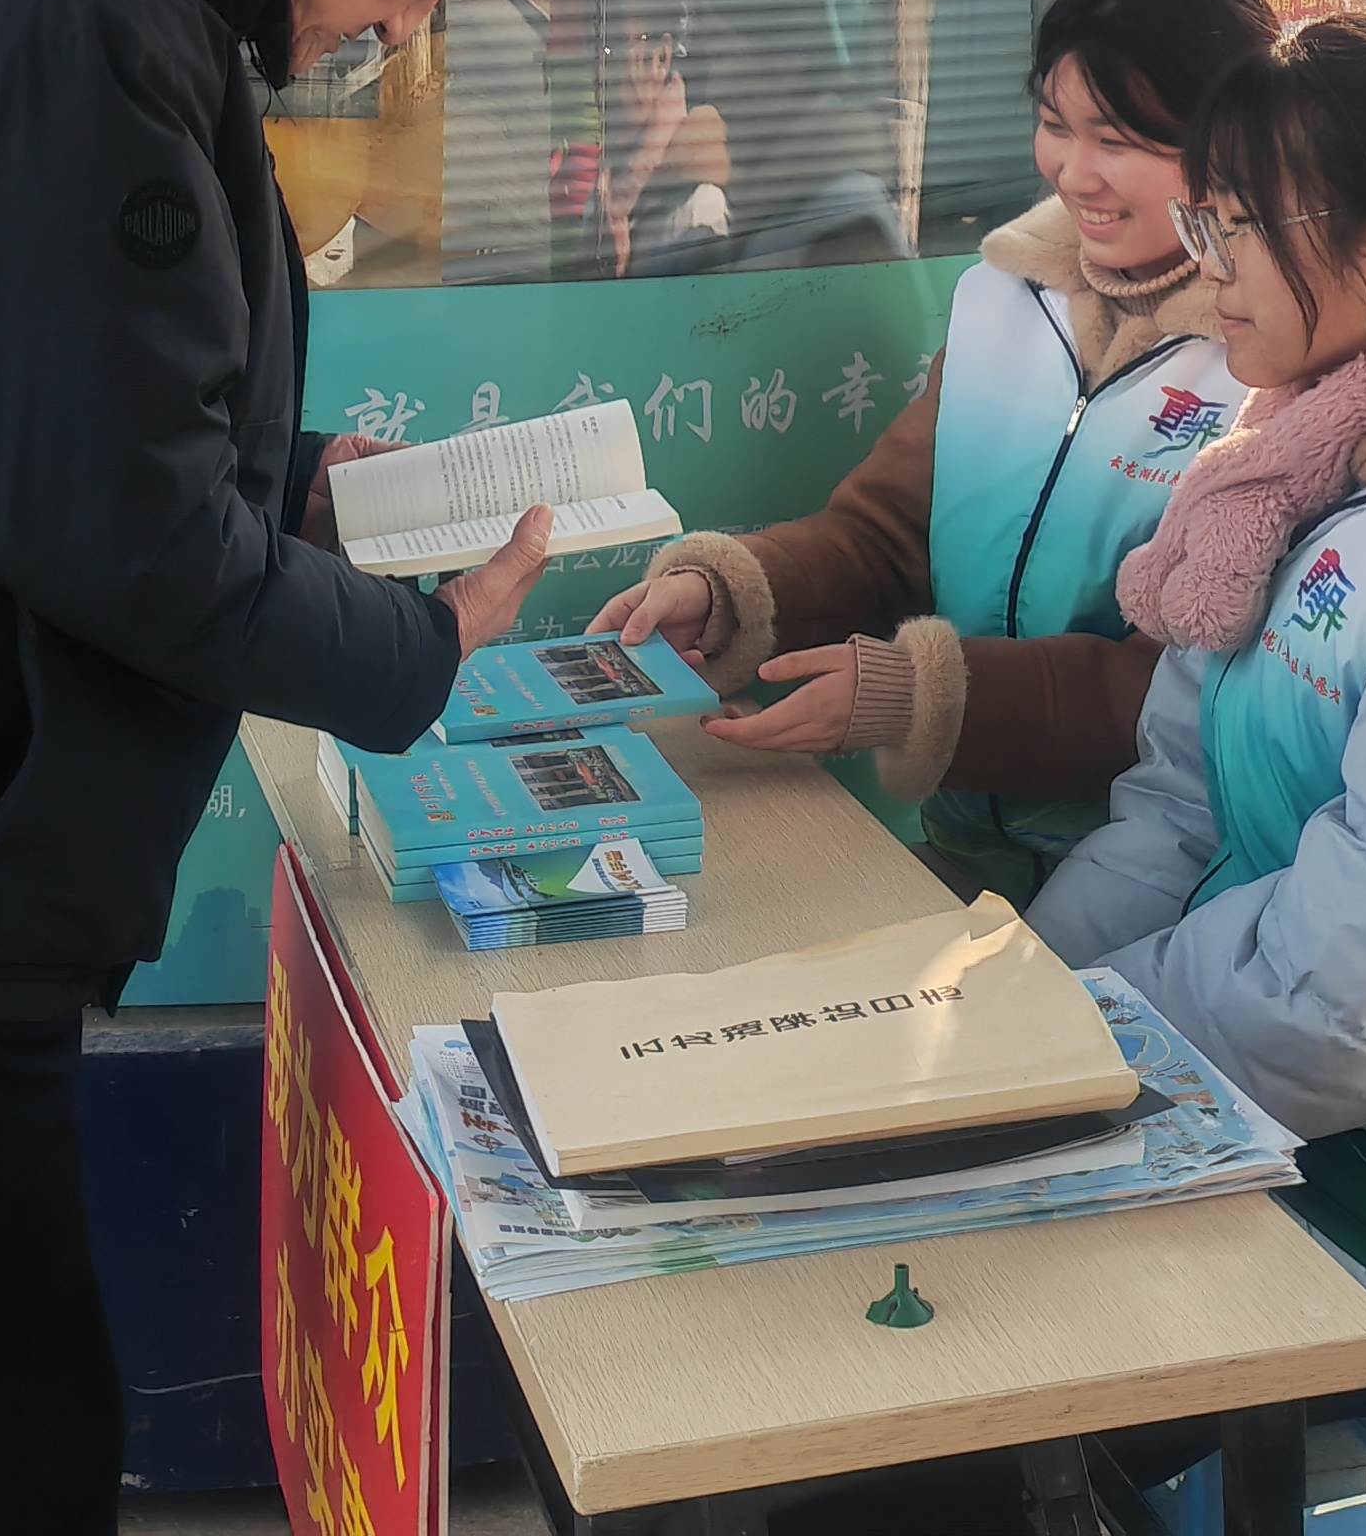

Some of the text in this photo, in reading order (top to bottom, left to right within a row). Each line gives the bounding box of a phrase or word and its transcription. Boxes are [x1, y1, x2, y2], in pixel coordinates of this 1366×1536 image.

[619, 984, 965, 1061] 云龙湖驿站日志
